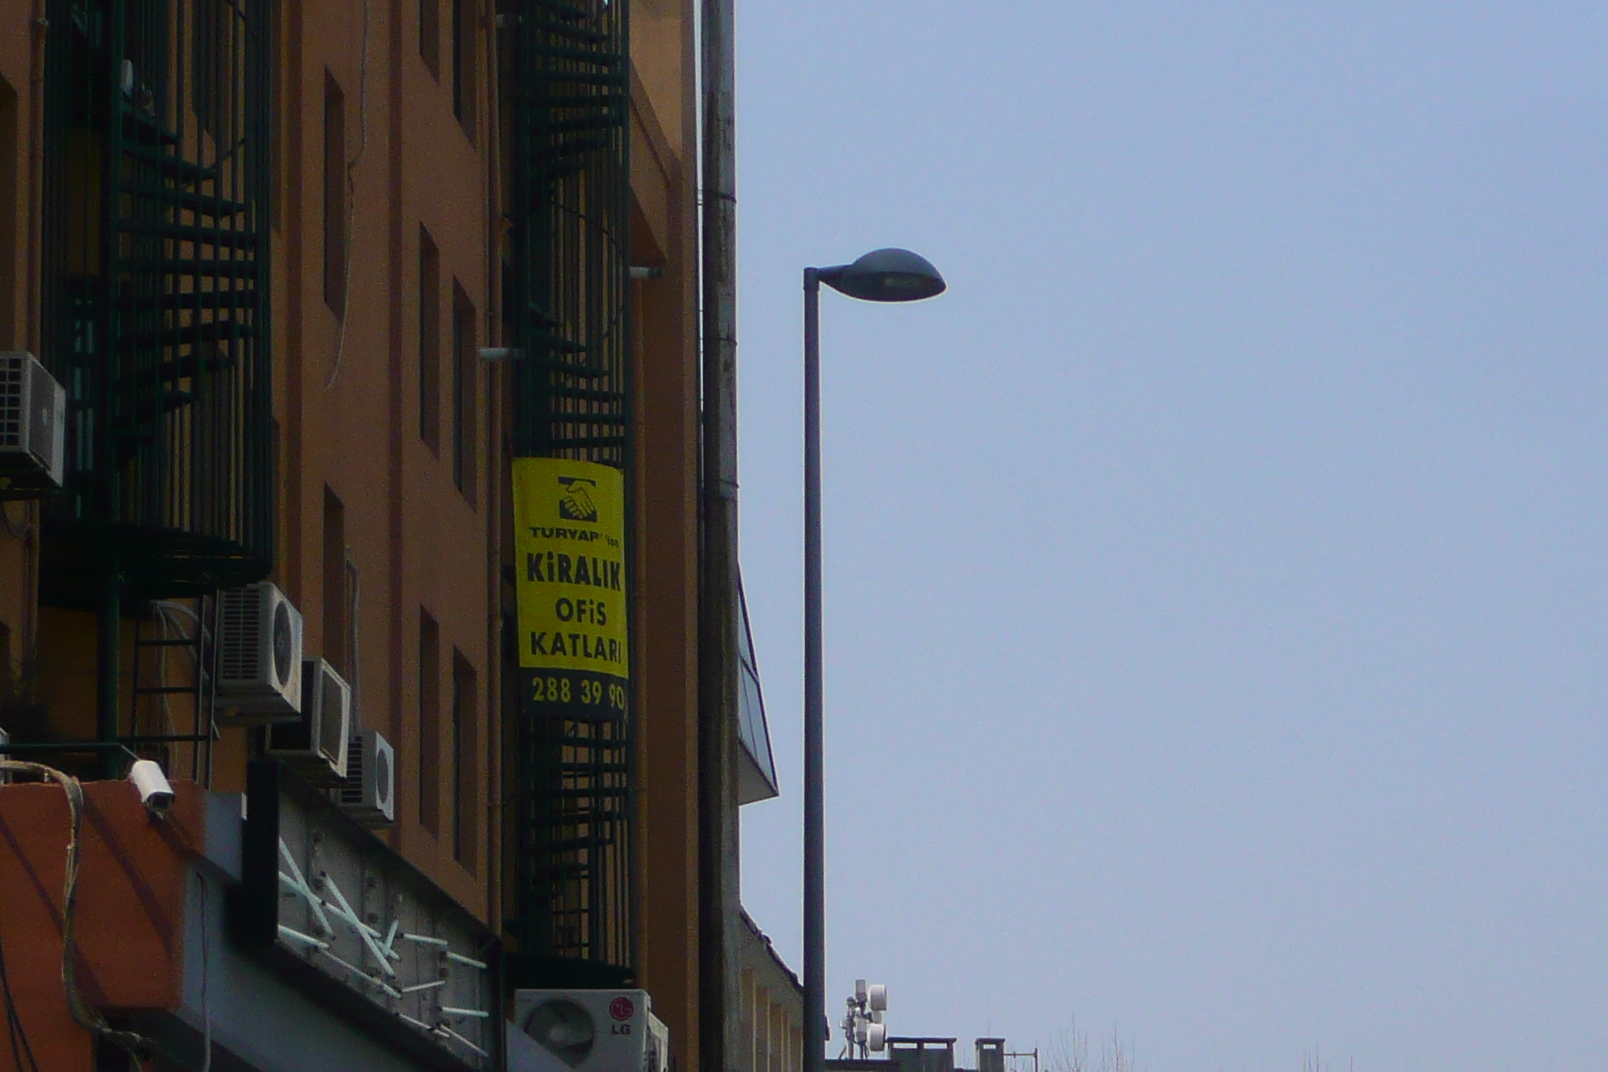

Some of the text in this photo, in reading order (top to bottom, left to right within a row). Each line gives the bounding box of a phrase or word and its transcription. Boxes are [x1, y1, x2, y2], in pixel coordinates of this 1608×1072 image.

[529, 527, 599, 542] TURYAP
[530, 631, 622, 665] KATLARI
[532, 676, 625, 711] 288 39 90
[611, 1024, 631, 1036] LG
